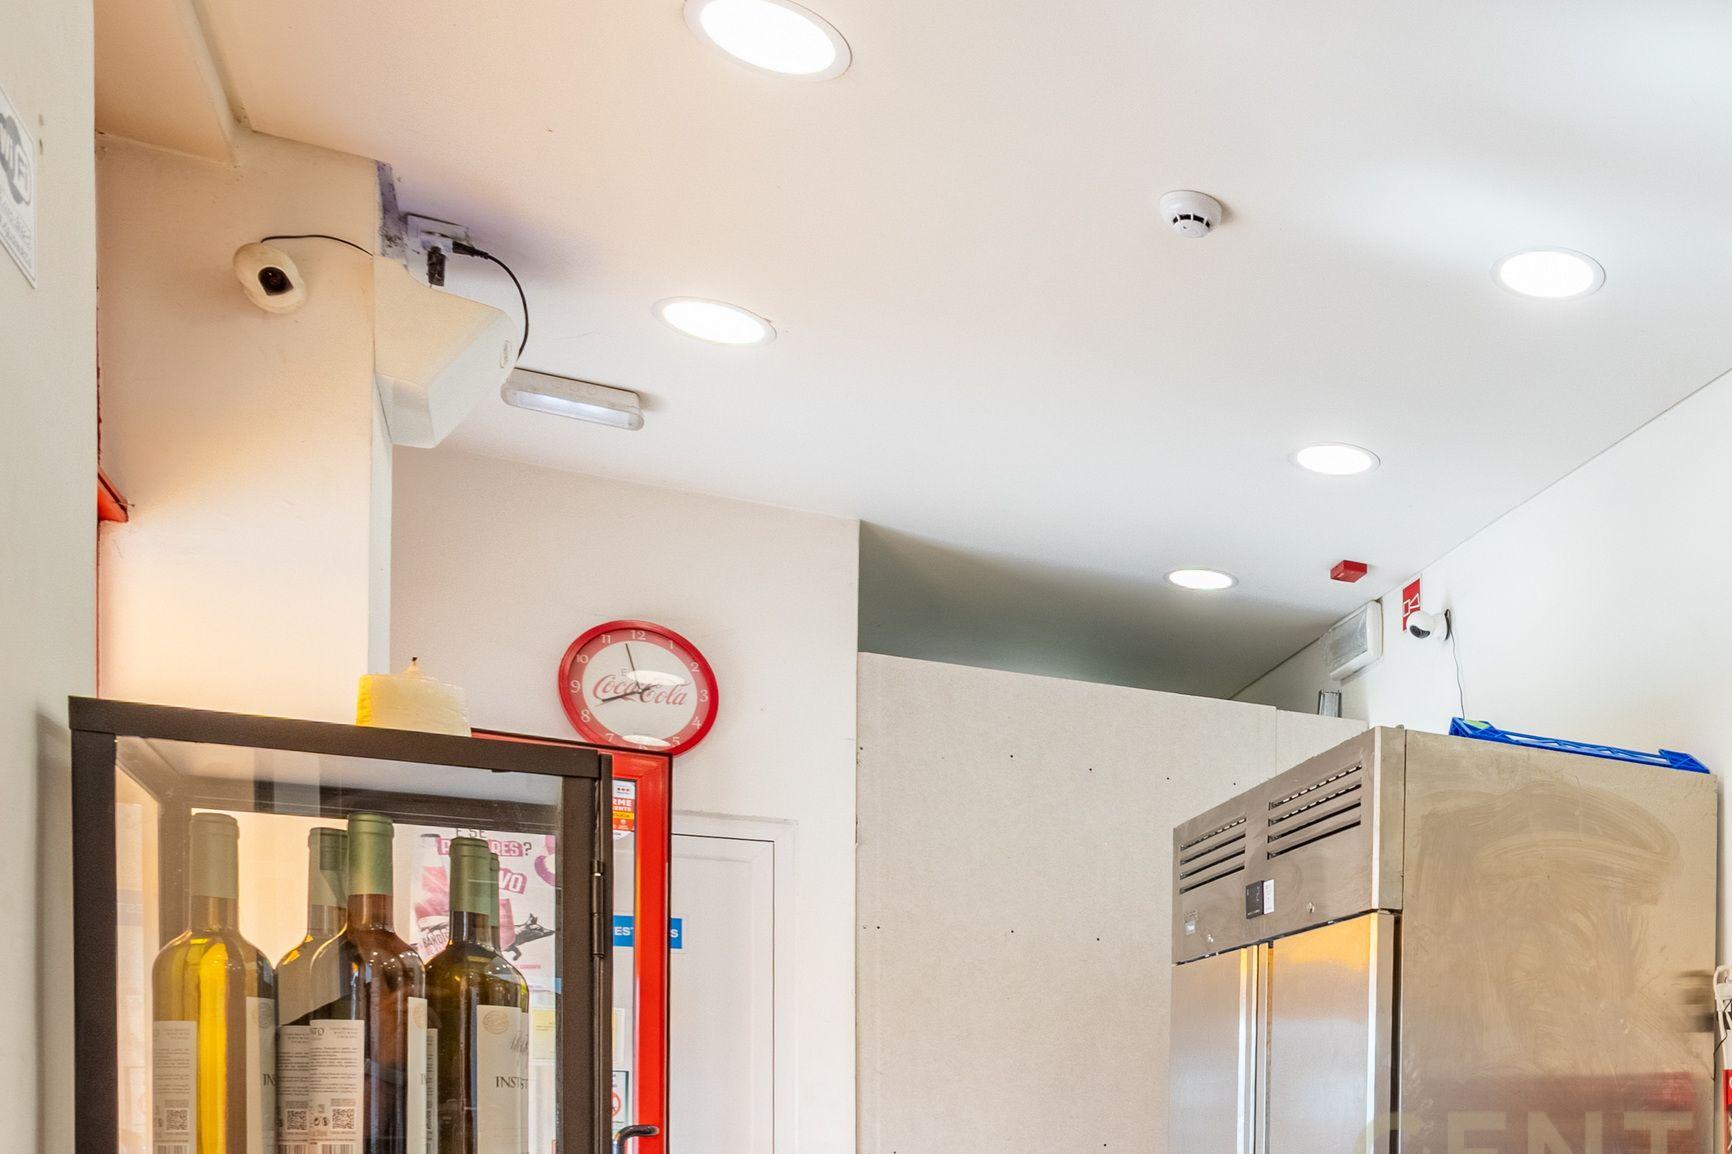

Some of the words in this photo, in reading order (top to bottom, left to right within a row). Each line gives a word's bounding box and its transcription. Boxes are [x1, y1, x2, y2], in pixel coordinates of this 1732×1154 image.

[602, 635, 612, 644] 11
[630, 630, 647, 641] 12
[668, 640, 676, 649] 1
[576, 655, 589, 665] 10
[691, 662, 700, 673] 2
[570, 680, 581, 694] 9
[699, 690, 709, 702] 3
[580, 709, 591, 723] 8
[691, 716, 702, 729] 4
[605, 733, 615, 743] 7
[672, 737, 681, 747] 5
